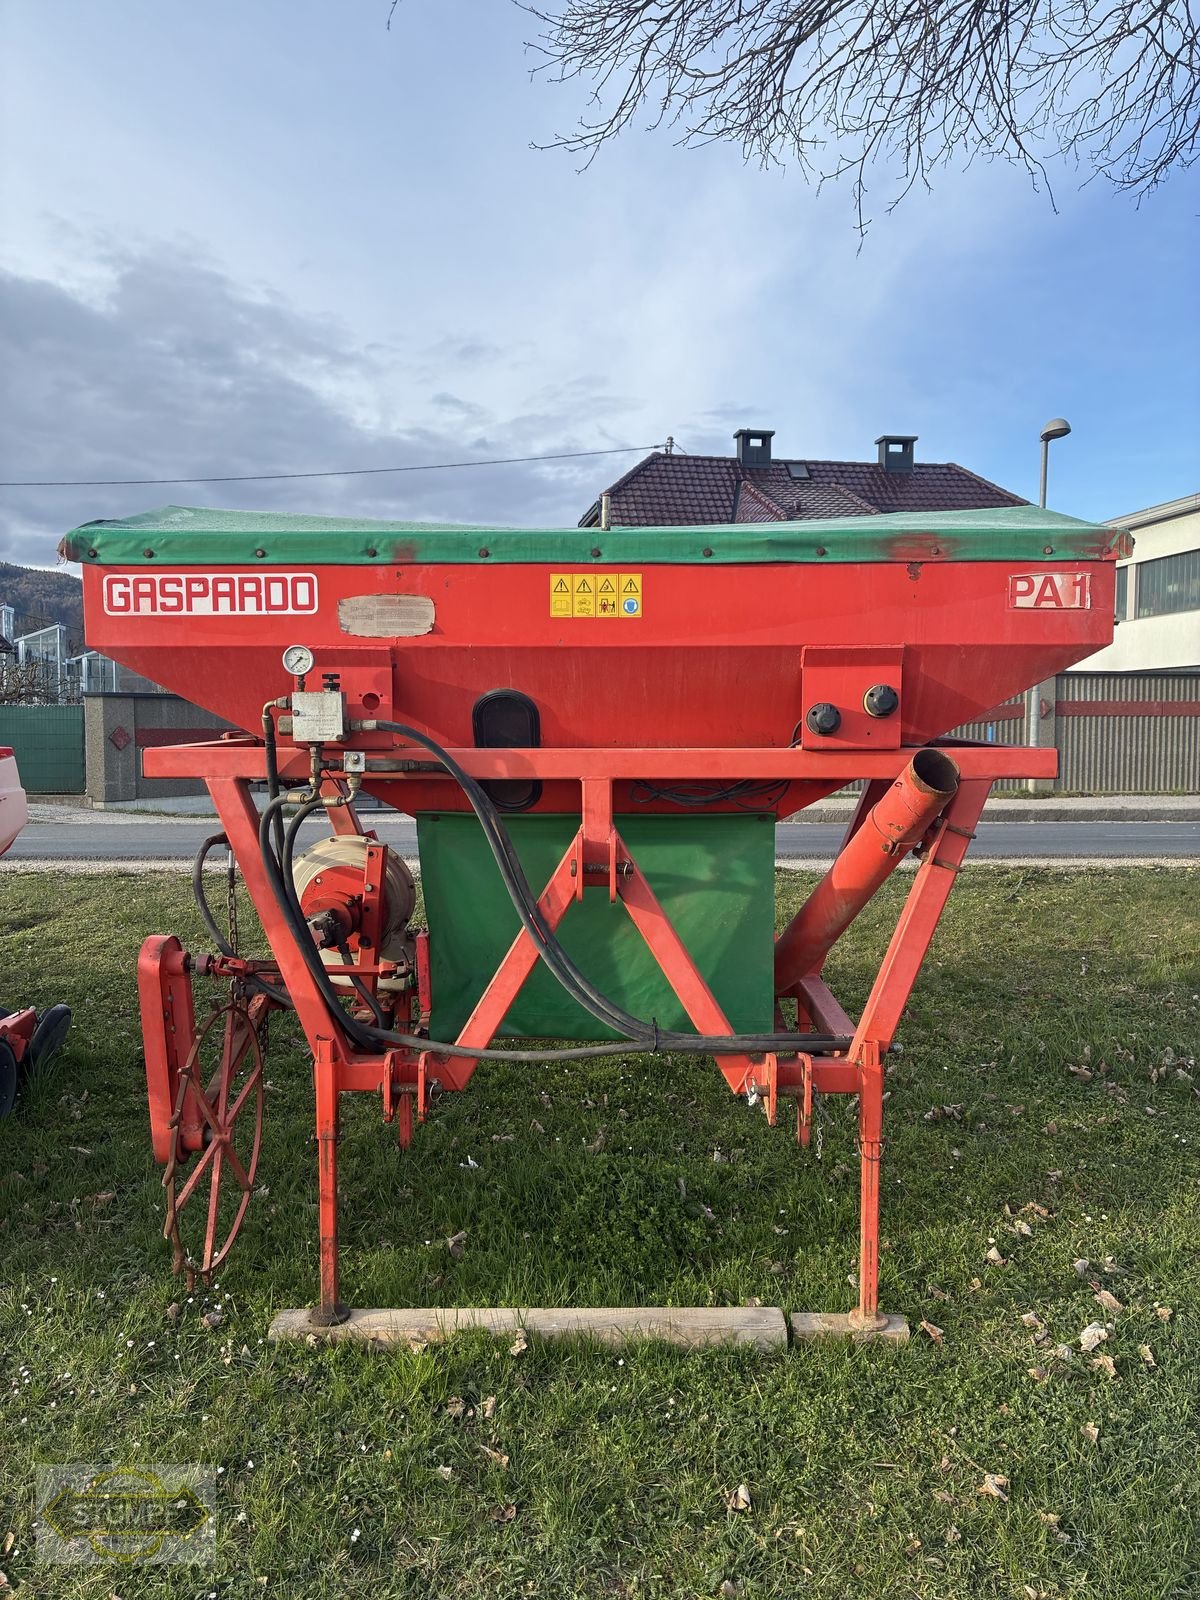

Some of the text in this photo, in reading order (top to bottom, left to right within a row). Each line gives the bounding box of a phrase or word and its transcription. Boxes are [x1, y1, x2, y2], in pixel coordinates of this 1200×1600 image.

[106, 576, 315, 613] GASPARDO
[1010, 575, 1087, 607] PA 1
